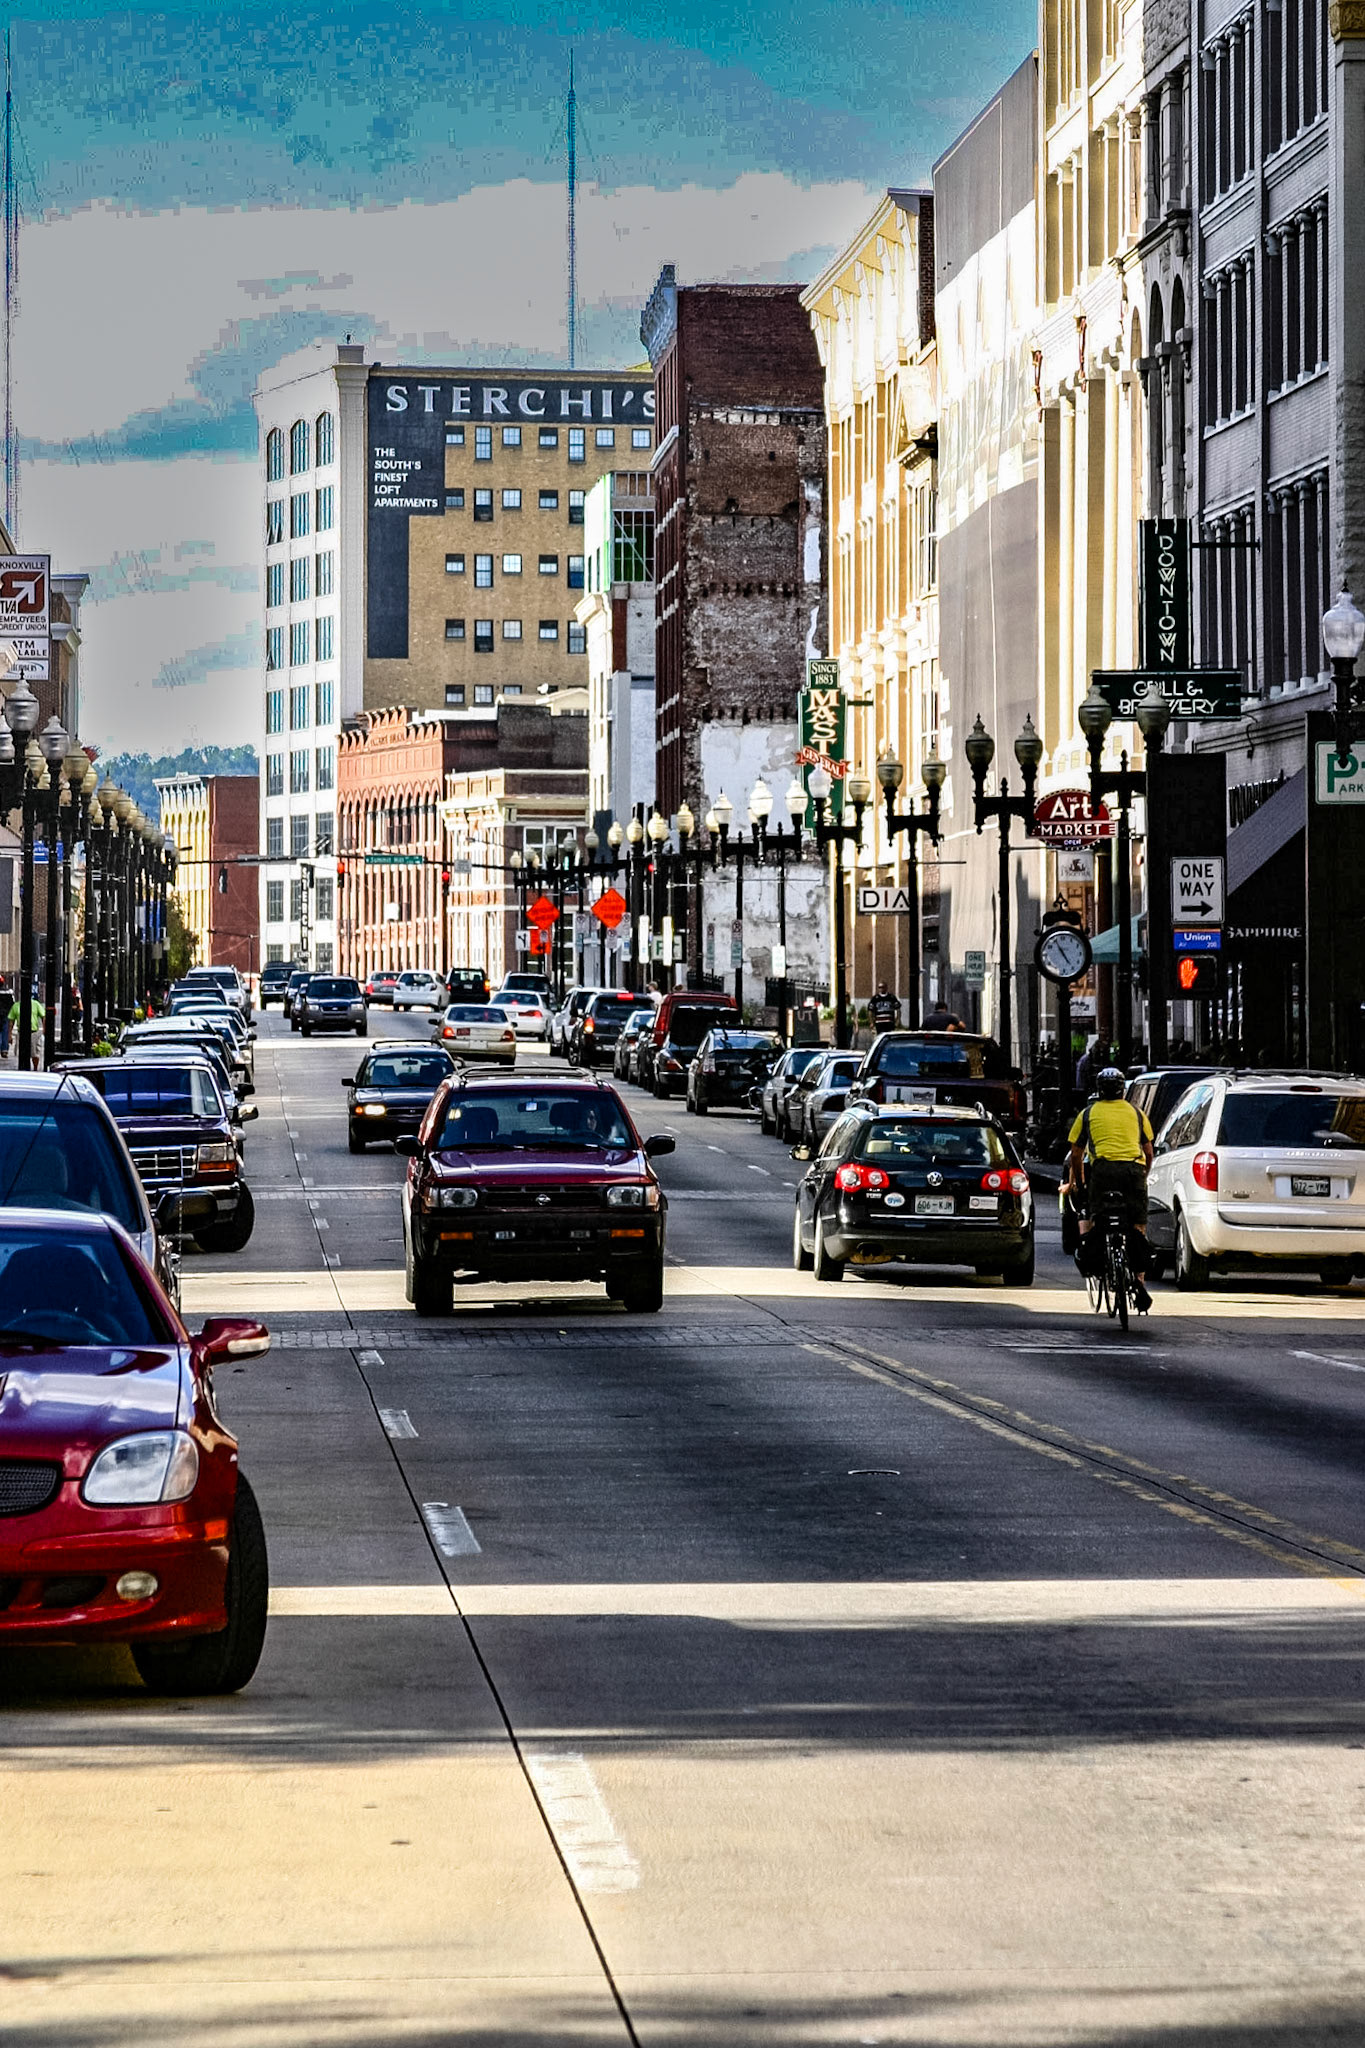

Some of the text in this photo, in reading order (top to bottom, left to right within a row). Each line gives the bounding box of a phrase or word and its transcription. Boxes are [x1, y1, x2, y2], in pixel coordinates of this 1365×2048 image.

[386, 384, 655, 418] STERCHI'S
[374, 447, 396, 458] THE
[374, 459, 422, 471] SOUTH'S
[374, 473, 408, 484] FINEST
[374, 484, 401, 495] LOFT
[374, 497, 438, 508] APARTMENTS
[0, 561, 46, 570] KNOXVILLE
[1157, 535, 1176, 663] DOWNTOWN
[0, 615, 46, 623] EMPLOYEES
[25, 623, 47, 631] UNION
[811, 662, 837, 675] SINCE
[815, 674, 834, 686] 1883
[805, 688, 840, 757] MAST
[802, 746, 842, 778] GENERAL
[1050, 796, 1092, 818] Art
[1041, 823, 1102, 836] MARKET
[1181, 863, 1214, 878] ONE
[1180, 882, 1214, 896] WAY
[1183, 933, 1212, 941] Union
